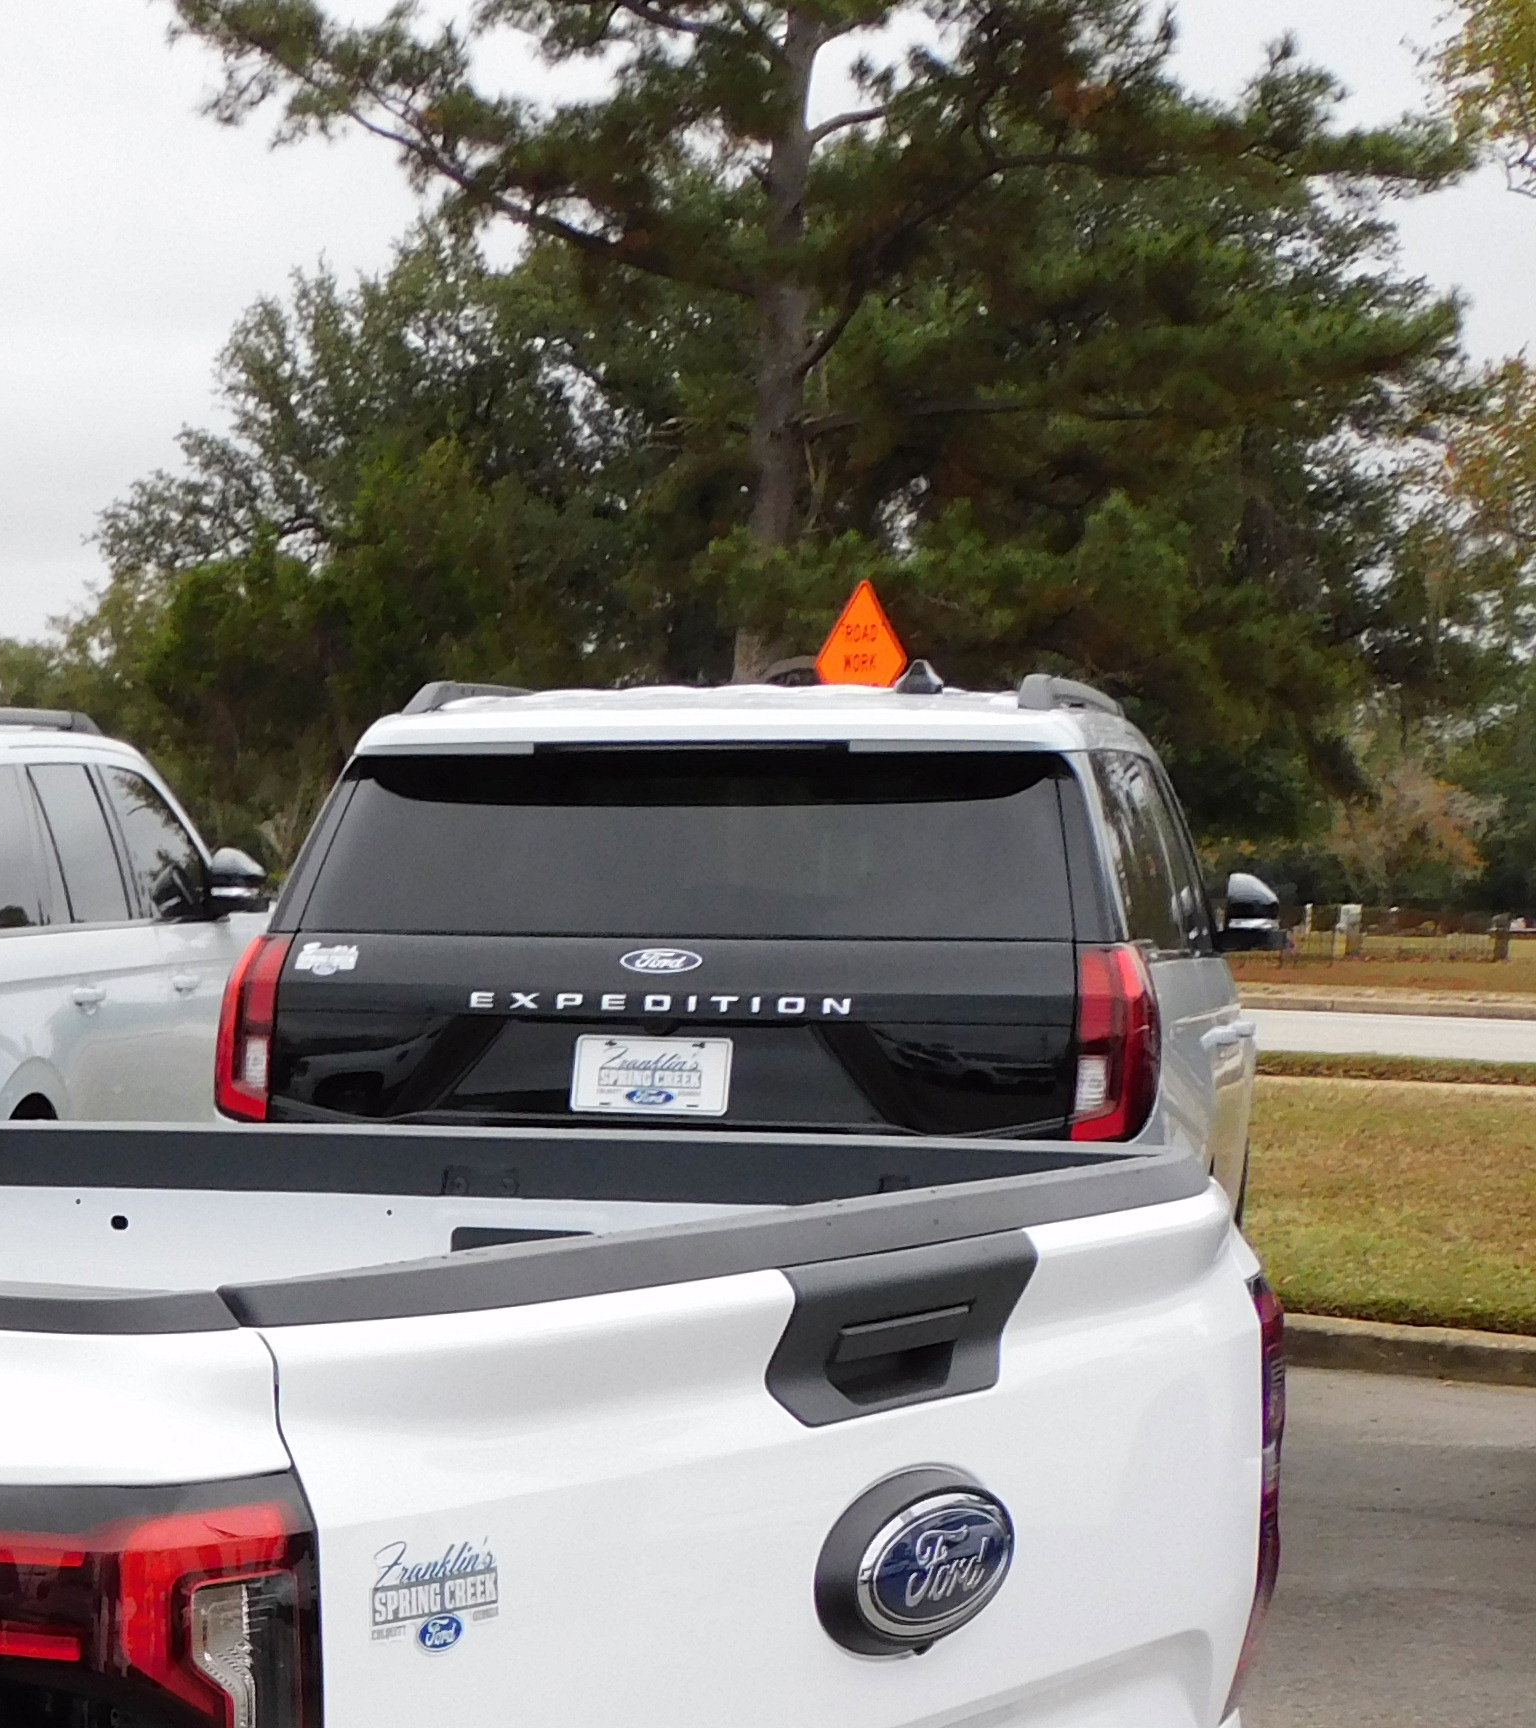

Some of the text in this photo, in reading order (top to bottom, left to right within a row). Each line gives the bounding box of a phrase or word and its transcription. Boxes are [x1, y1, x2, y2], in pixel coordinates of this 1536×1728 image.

[845, 624, 876, 642] ROAD
[844, 654, 876, 672] WORK
[633, 951, 687, 970] Ford
[469, 990, 852, 1015] EXPEDITION
[599, 1046, 700, 1071] Franklin's
[599, 1070, 701, 1088] SPRING CREEK
[632, 1089, 667, 1103] Ford
[373, 1535, 495, 1590] Franklin's
[904, 1523, 991, 1608] Ford
[373, 1572, 497, 1623] SPRING CREEK
[424, 1617, 459, 1647] Ford
